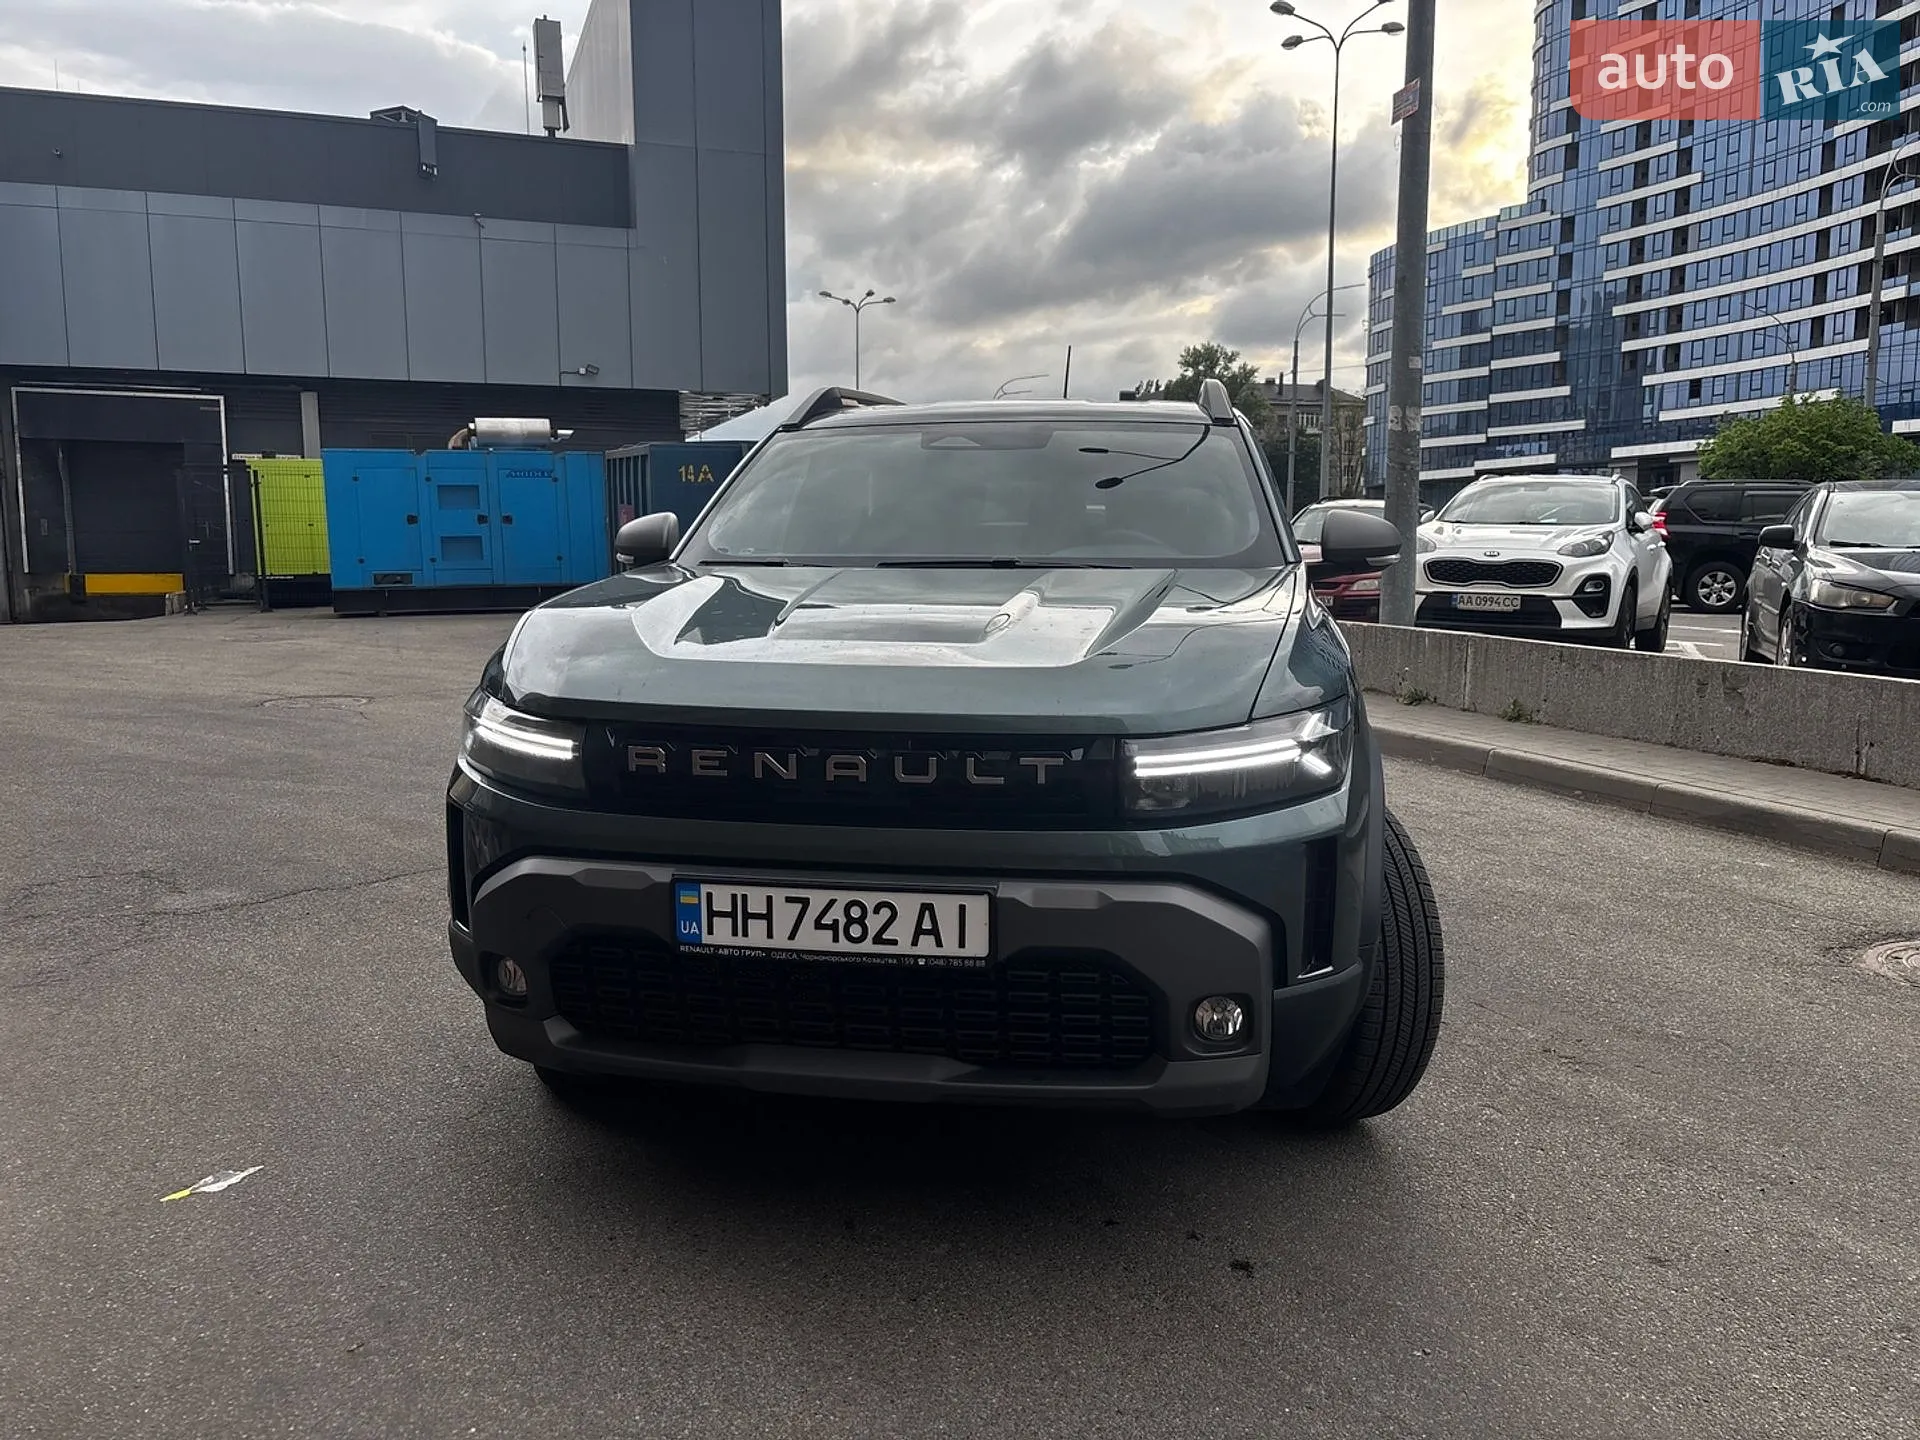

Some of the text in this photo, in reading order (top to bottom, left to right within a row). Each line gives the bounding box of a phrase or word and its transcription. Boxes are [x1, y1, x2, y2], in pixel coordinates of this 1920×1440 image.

[1459, 595, 1474, 606] AA
[1475, 596, 1501, 608] 0994
[1503, 597, 1519, 608] CC
[627, 745, 1065, 785] RENAULT
[680, 921, 700, 935] UA
[705, 891, 967, 949] HH 7482 AI
